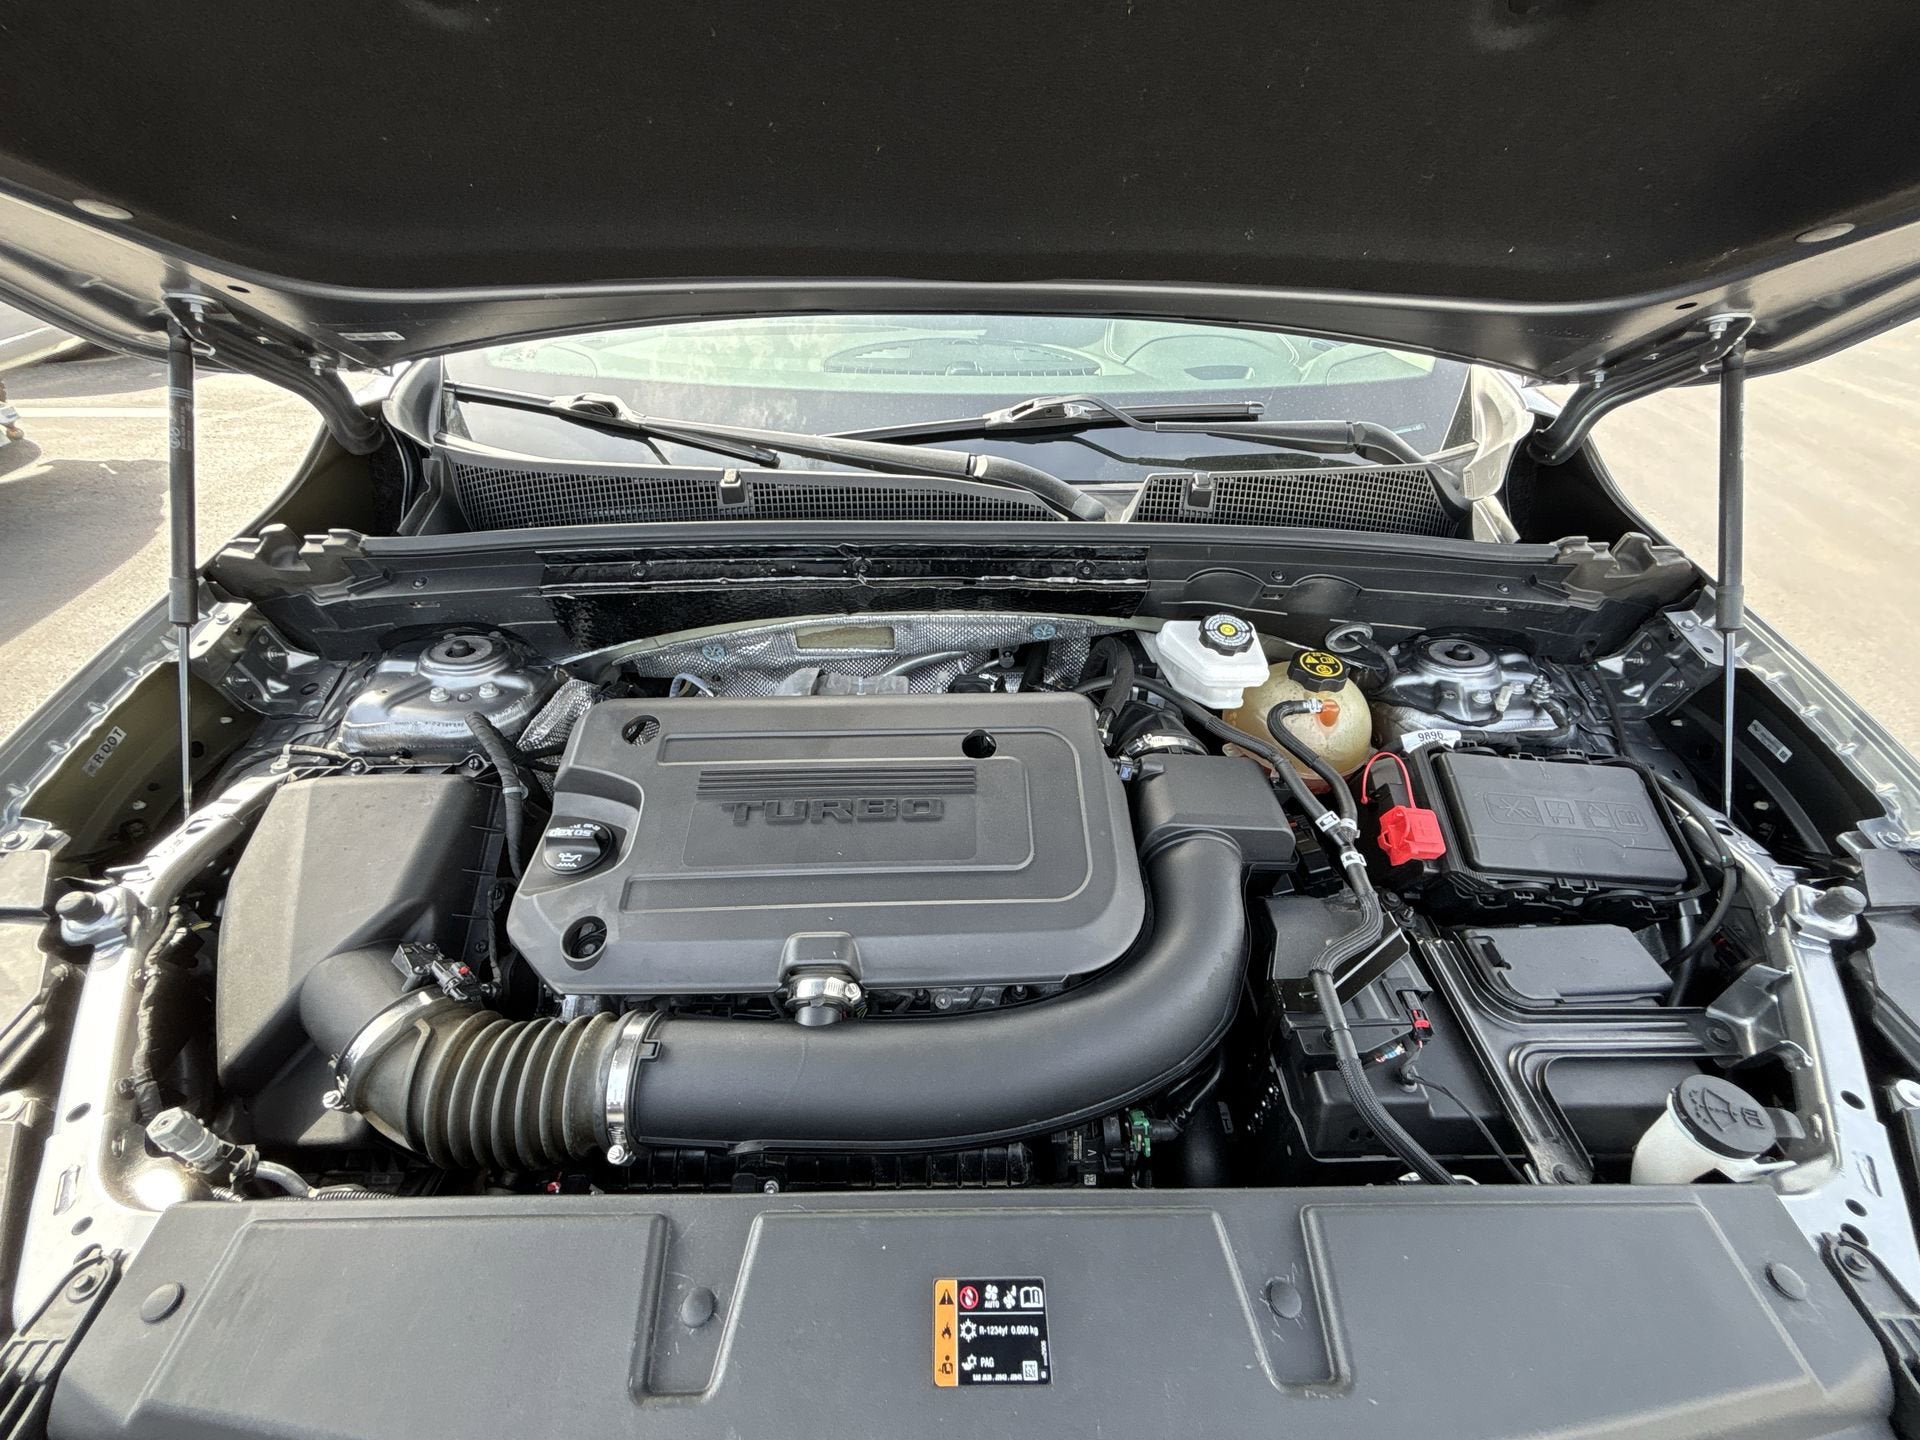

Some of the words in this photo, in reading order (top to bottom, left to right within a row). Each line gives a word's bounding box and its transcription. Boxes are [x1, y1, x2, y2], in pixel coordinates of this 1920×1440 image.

[1417, 731, 1444, 742] 9896
[719, 797, 945, 827] TURBO
[984, 1300, 1000, 1309] AUTO
[1029, 1324, 1039, 1337] kg
[980, 1357, 995, 1368] PAG
